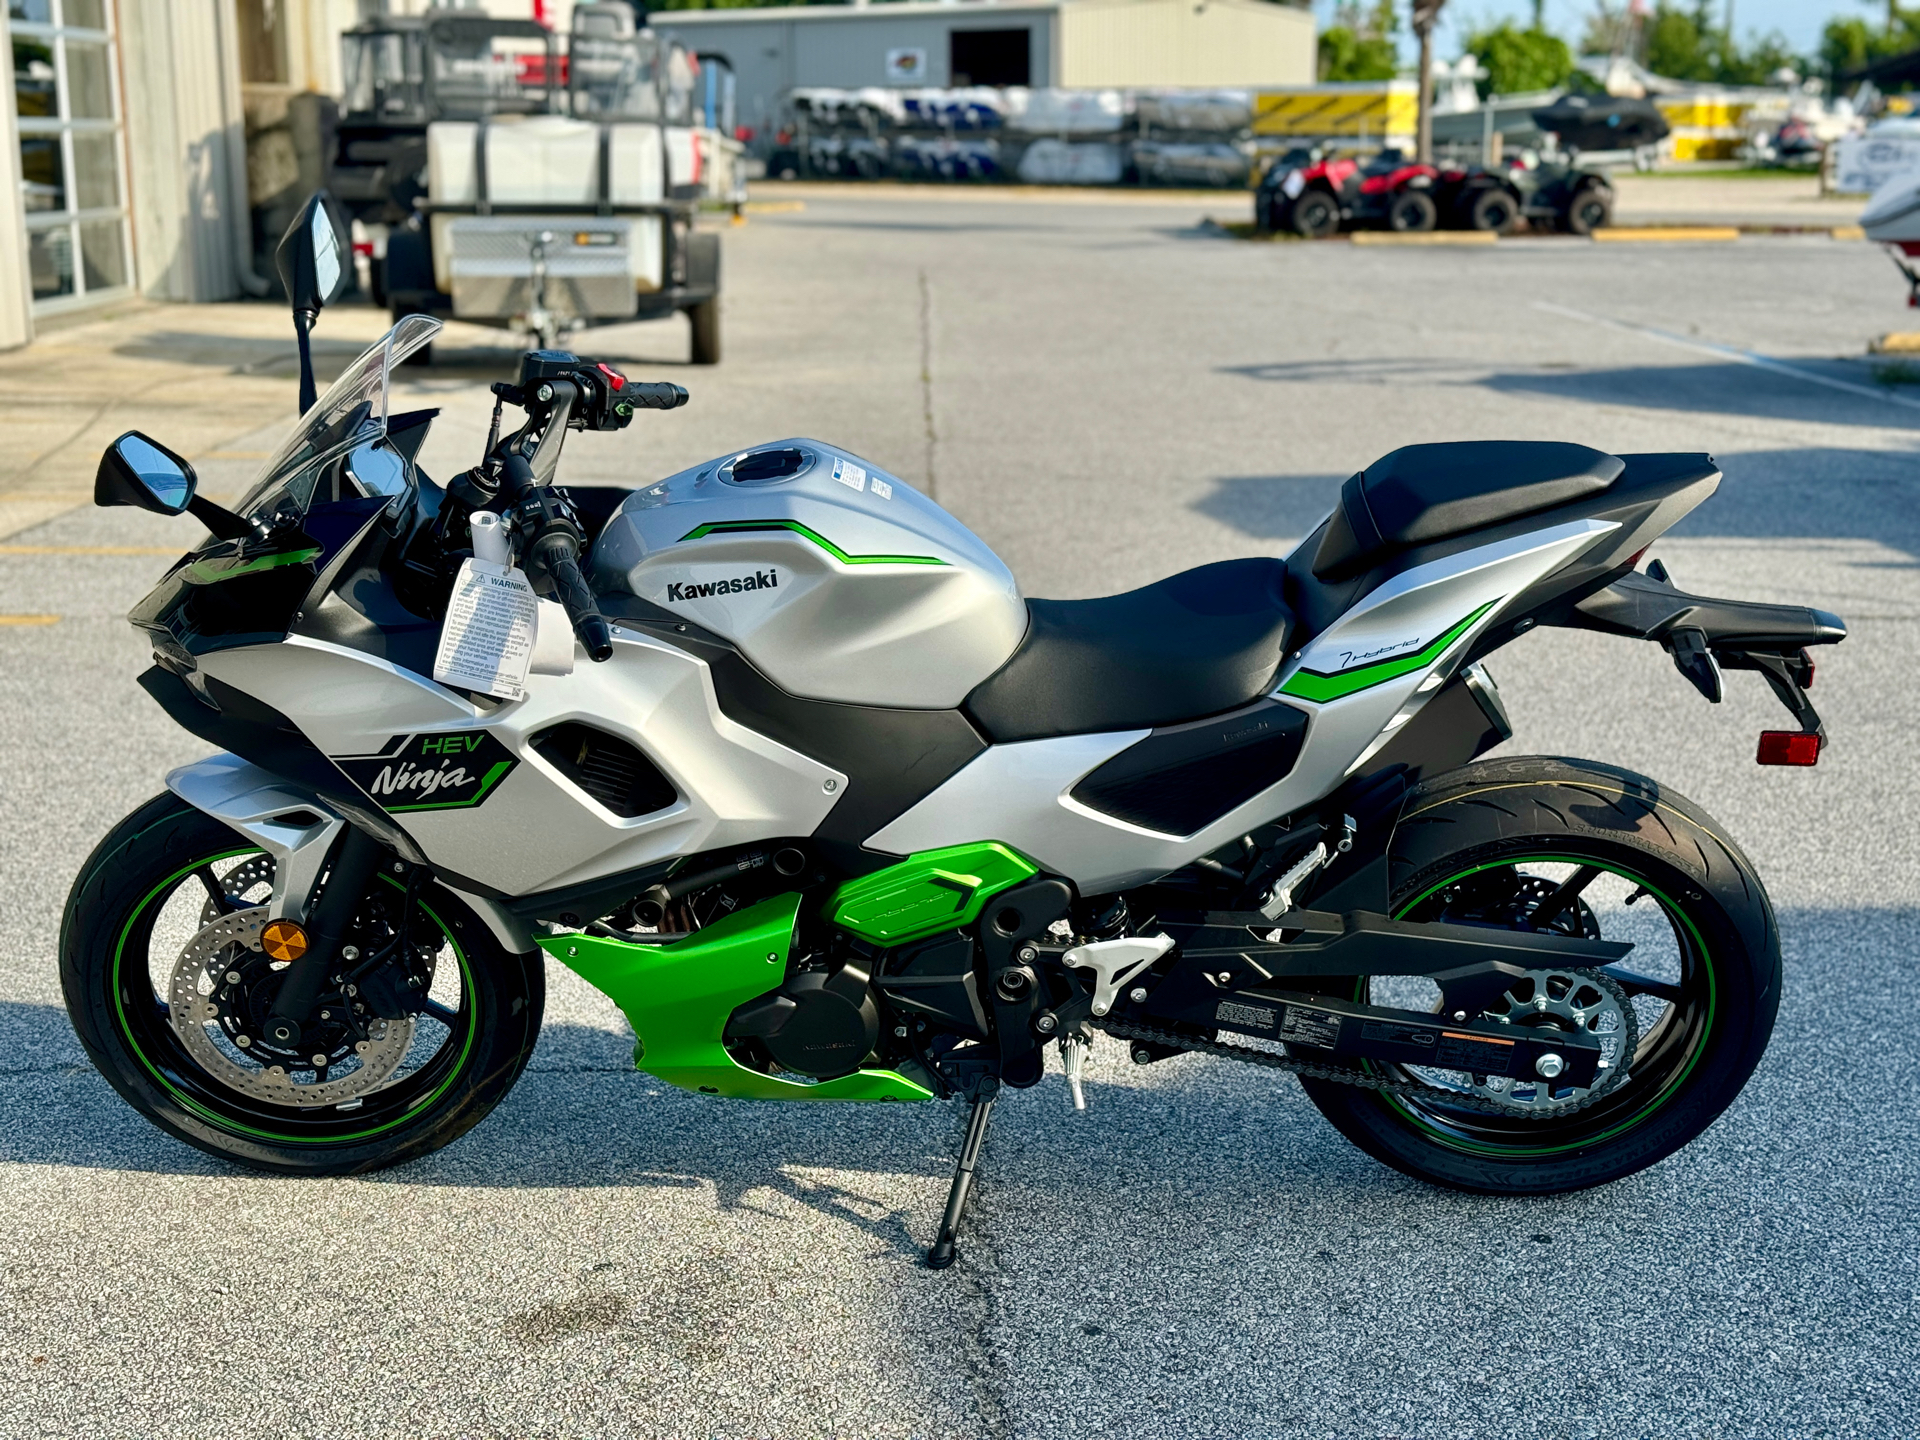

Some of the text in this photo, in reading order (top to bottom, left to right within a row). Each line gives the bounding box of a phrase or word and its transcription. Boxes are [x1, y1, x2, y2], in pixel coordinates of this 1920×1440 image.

[491, 577, 528, 592] WARNING
[667, 569, 778, 602] Kawasaki
[1339, 637, 1420, 668] 7 Hybrid
[421, 735, 485, 755] HEV
[371, 758, 476, 800] Ninja
[1576, 824, 1664, 854] SPORTMAX
